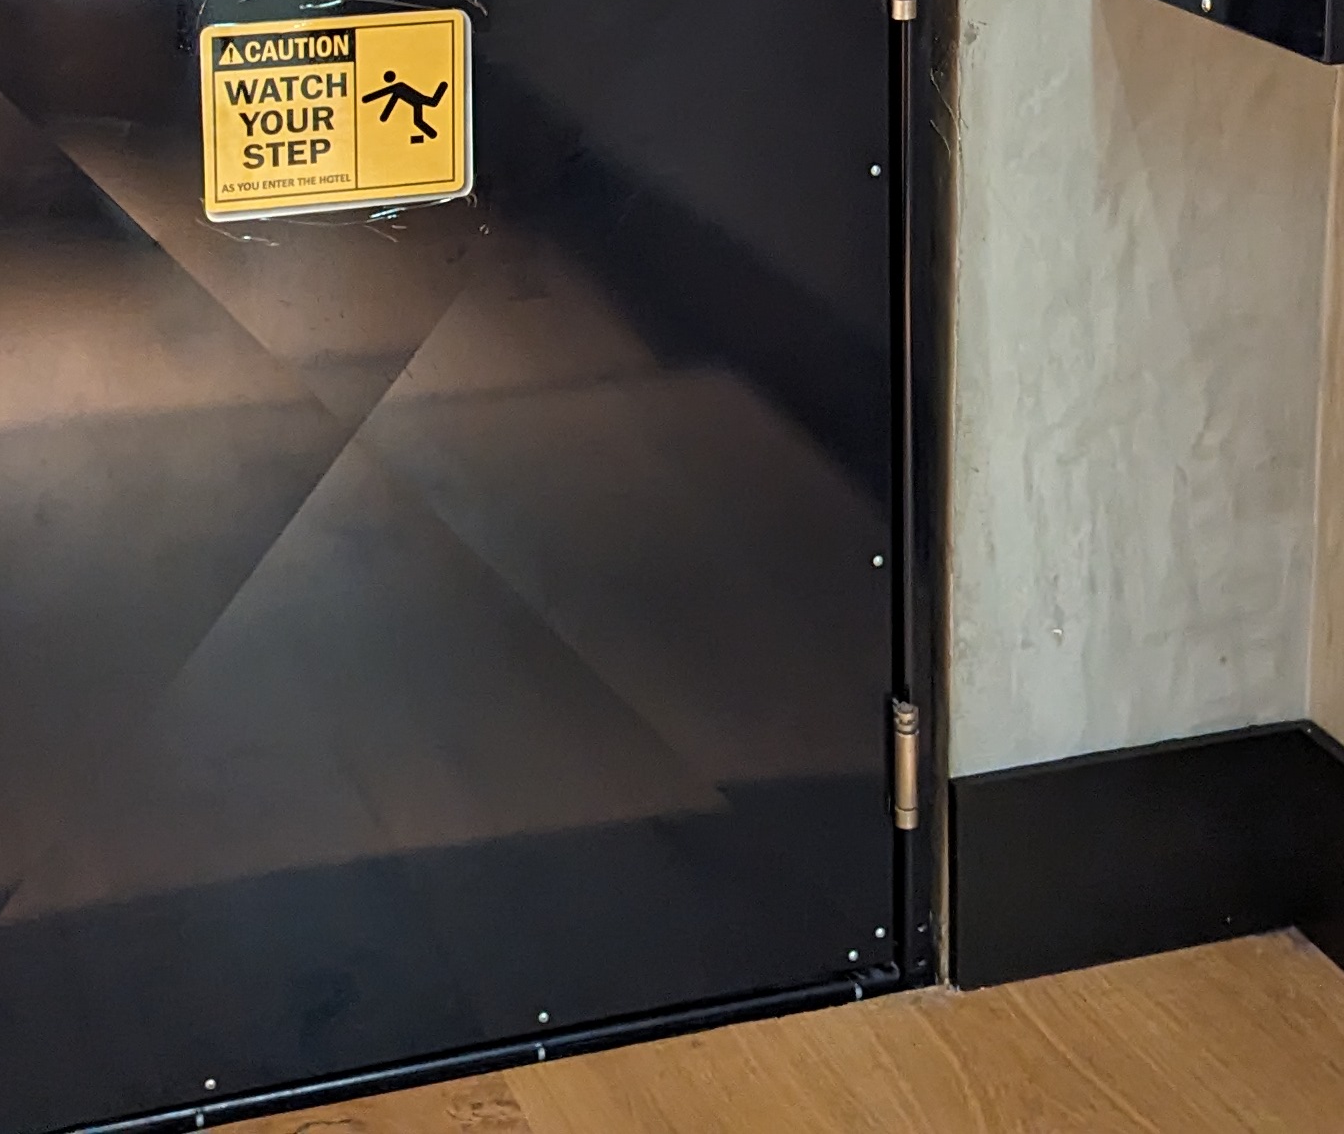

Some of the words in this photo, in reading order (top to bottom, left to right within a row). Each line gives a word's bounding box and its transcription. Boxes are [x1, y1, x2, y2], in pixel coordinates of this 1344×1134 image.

[244, 34, 350, 63] CAUTION
[224, 72, 348, 106] WATCH
[239, 106, 335, 137] YOUR
[242, 138, 332, 170] STEP
[221, 183, 235, 193] AS
[237, 181, 259, 192] YOU
[262, 178, 295, 190] ENTER
[297, 176, 317, 186] THE
[319, 173, 351, 184] HOTEL
